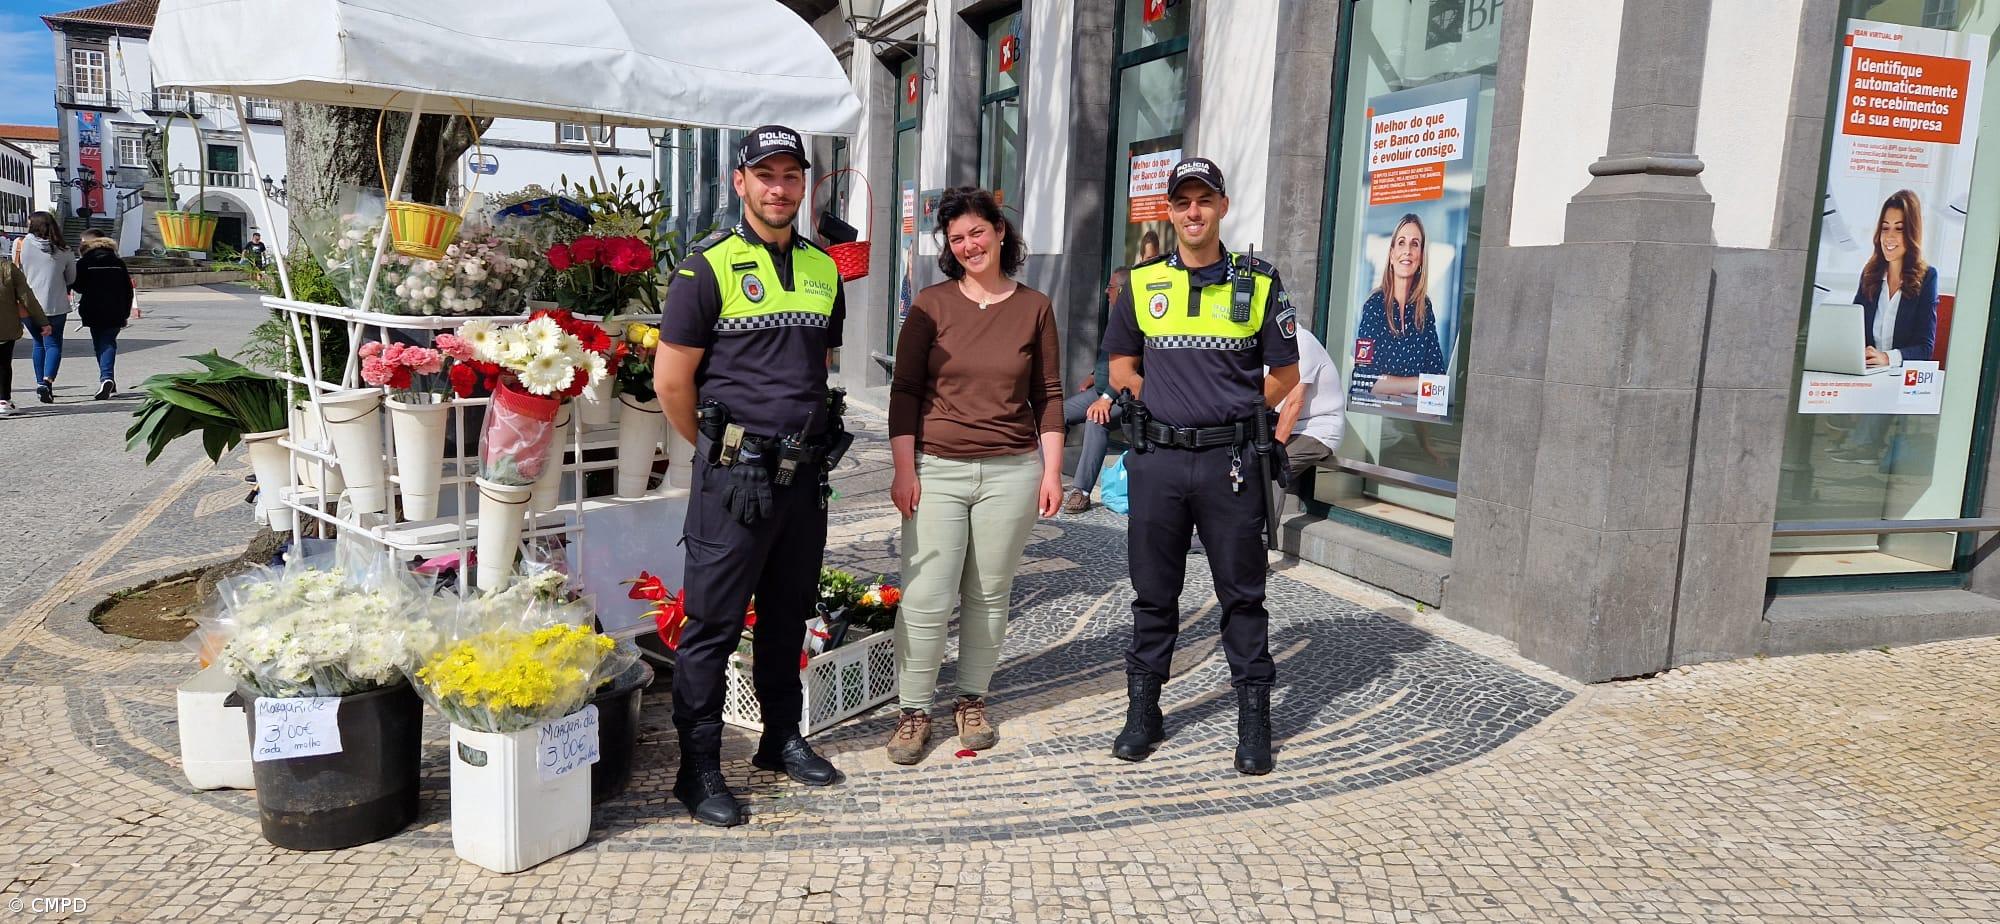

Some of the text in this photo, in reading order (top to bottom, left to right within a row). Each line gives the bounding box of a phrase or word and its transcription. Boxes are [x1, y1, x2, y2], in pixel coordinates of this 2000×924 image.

[1856, 57, 1923, 78] Identifique
[1854, 77, 1958, 99] automaticamente
[1852, 95, 1949, 115] os recebimentos
[1374, 113, 1445, 135] Melhor do que
[1850, 110, 1943, 132] da sua empresa
[758, 131, 797, 142] POLÍCIA
[1373, 127, 1460, 150] ser Banco do ano,
[759, 139, 798, 149] MUNICIPAL
[1372, 142, 1457, 164] é evoluir consigo.
[1132, 157, 1171, 170] Melhor do que
[1176, 161, 1210, 173] POLÍCIA
[1141, 170, 1158, 179] Banco
[1158, 168, 1166, 177] do
[1176, 167, 1210, 178] MUNICIPAL
[803, 279, 833, 293] POLÍCIA
[1917, 371, 1934, 384] BPI
[1431, 385, 1446, 396] BPI
[259, 742, 282, 754] cada
